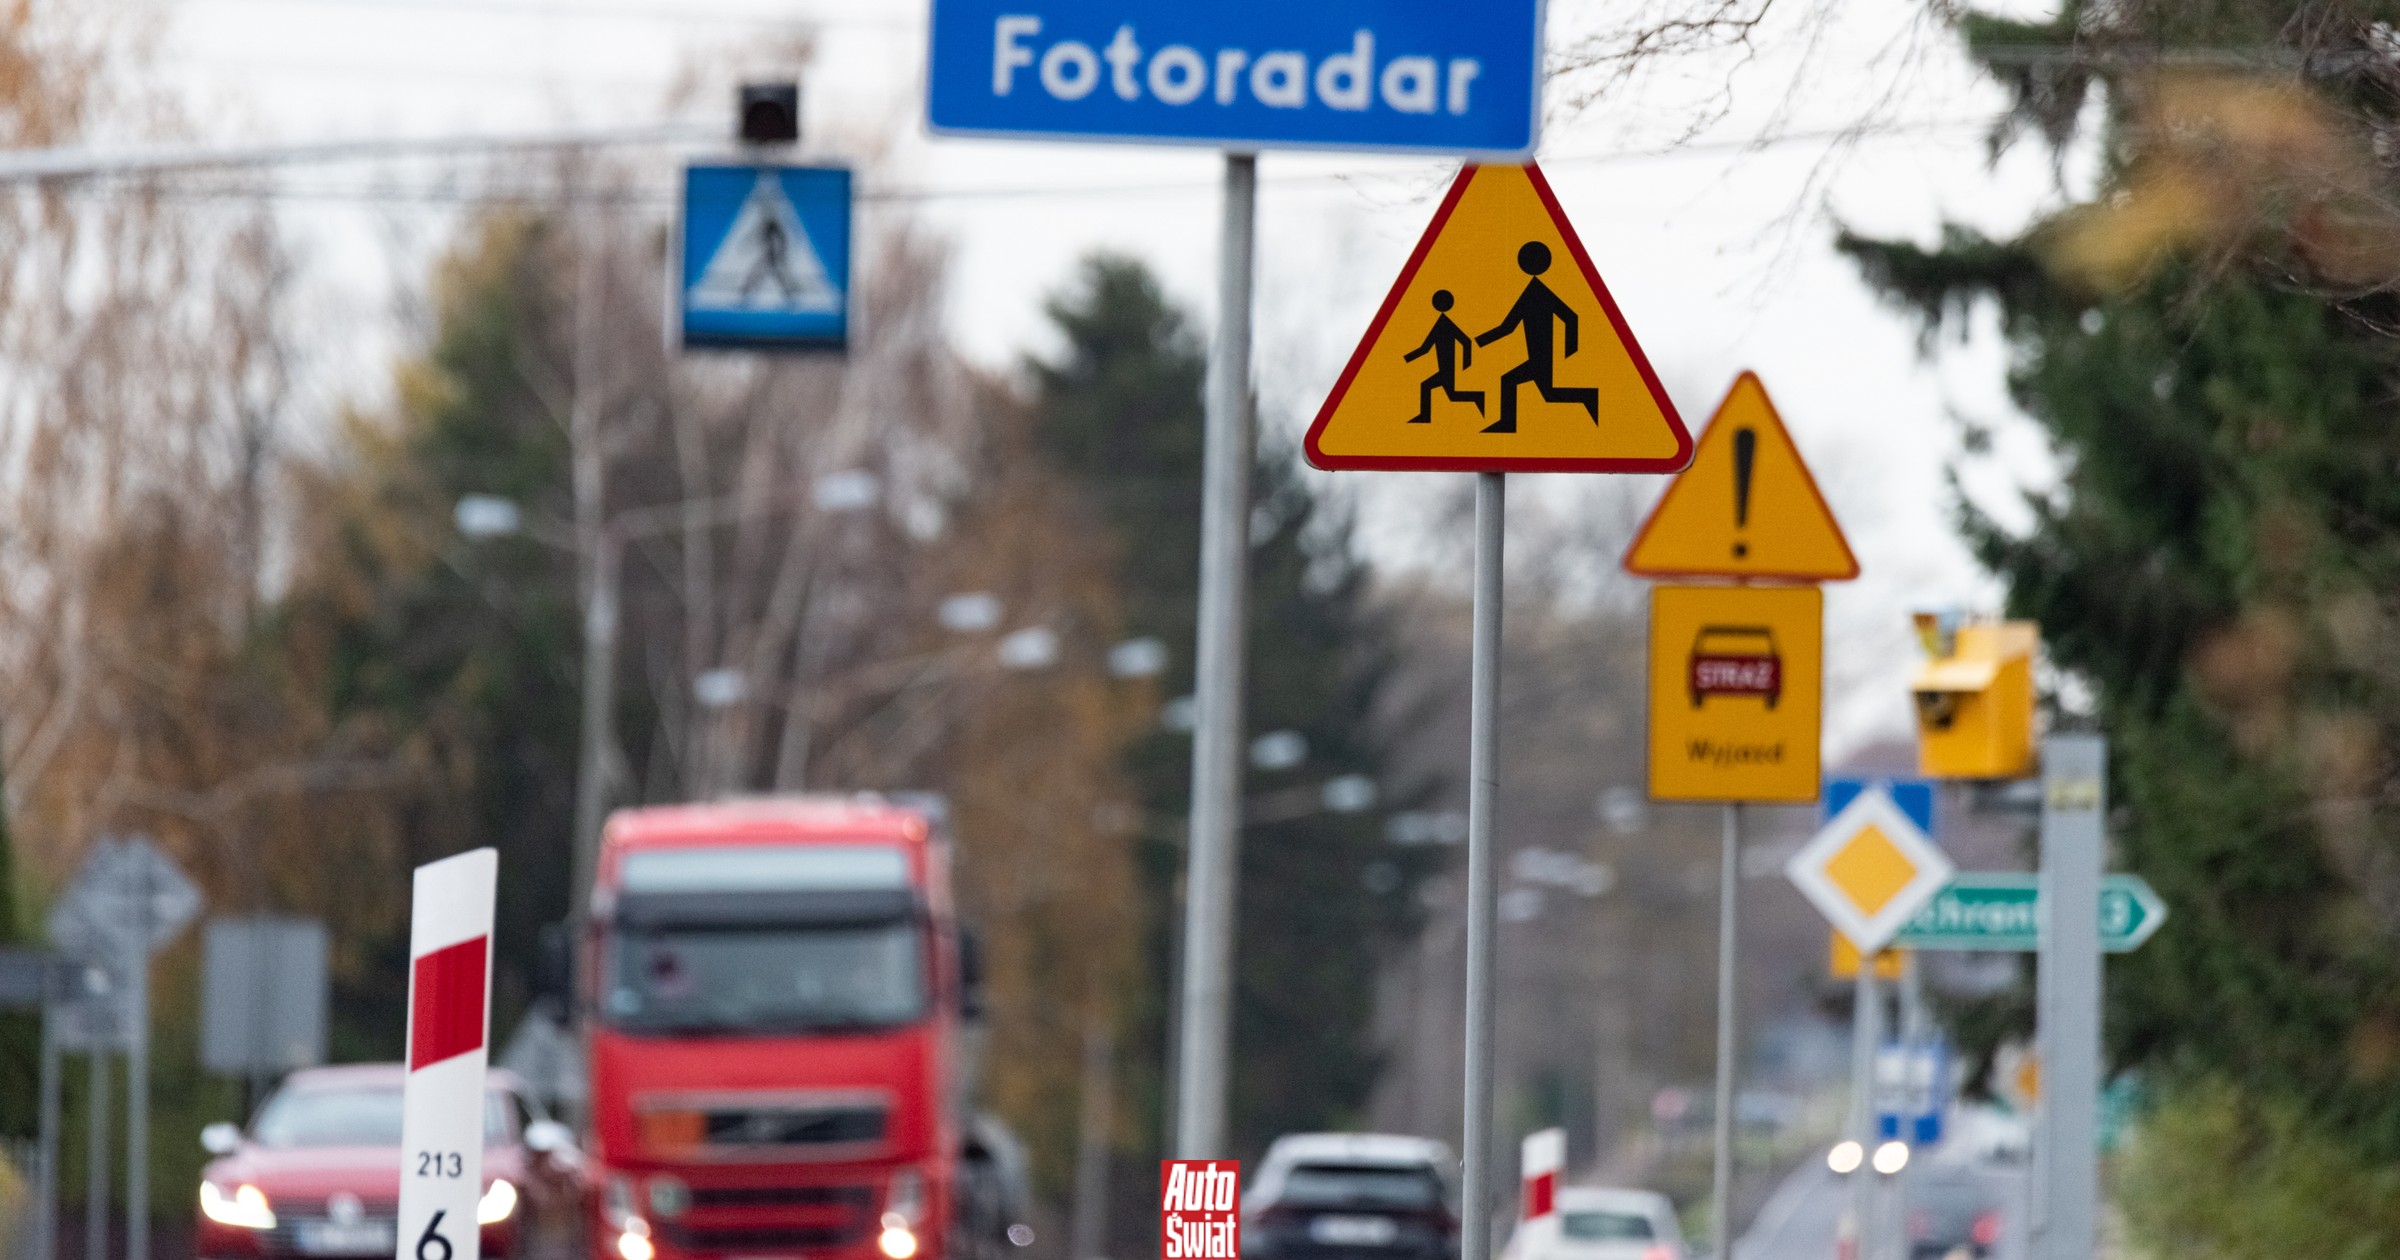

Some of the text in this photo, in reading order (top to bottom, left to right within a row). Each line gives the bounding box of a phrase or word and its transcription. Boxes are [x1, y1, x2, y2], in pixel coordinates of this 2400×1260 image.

[992, 15, 1480, 116] Fotoradar
[1684, 738, 1784, 769] Wyjazd
[417, 1151, 462, 1178] 213
[416, 1209, 453, 1260] 6
